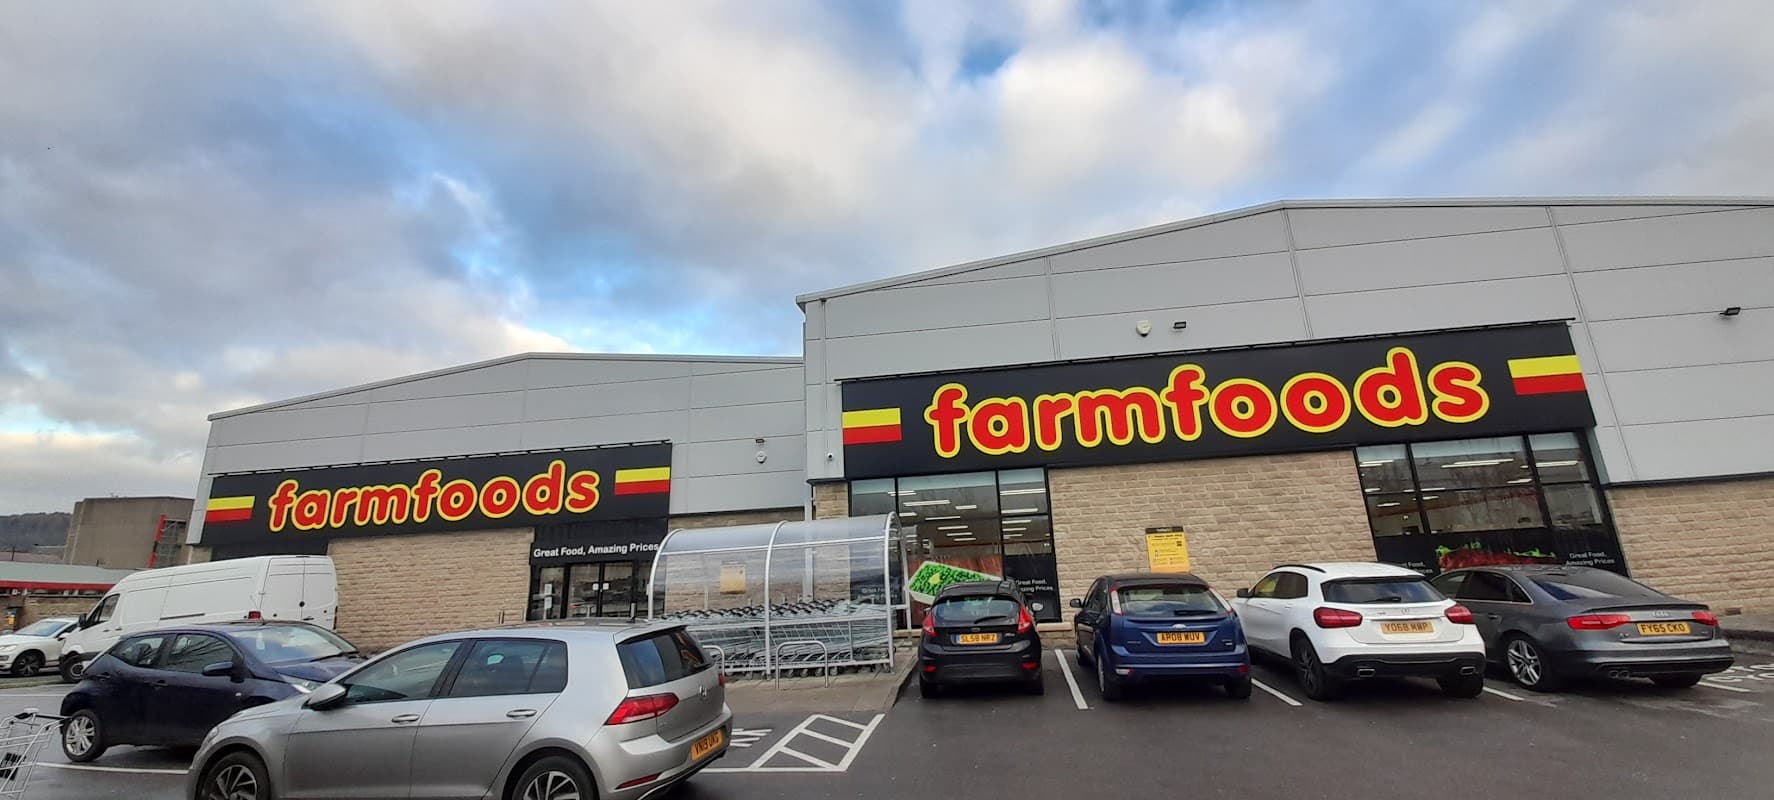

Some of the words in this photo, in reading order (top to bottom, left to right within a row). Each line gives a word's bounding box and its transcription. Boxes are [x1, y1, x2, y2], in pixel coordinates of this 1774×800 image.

[924, 347, 1490, 459] farmfoods
[268, 459, 600, 532] farmfoods
[533, 548, 559, 558] Great
[560, 546, 586, 556] Food,
[587, 543, 628, 554] Amazing
[629, 542, 659, 552] Prices
[1640, 623, 1666, 634] FY65
